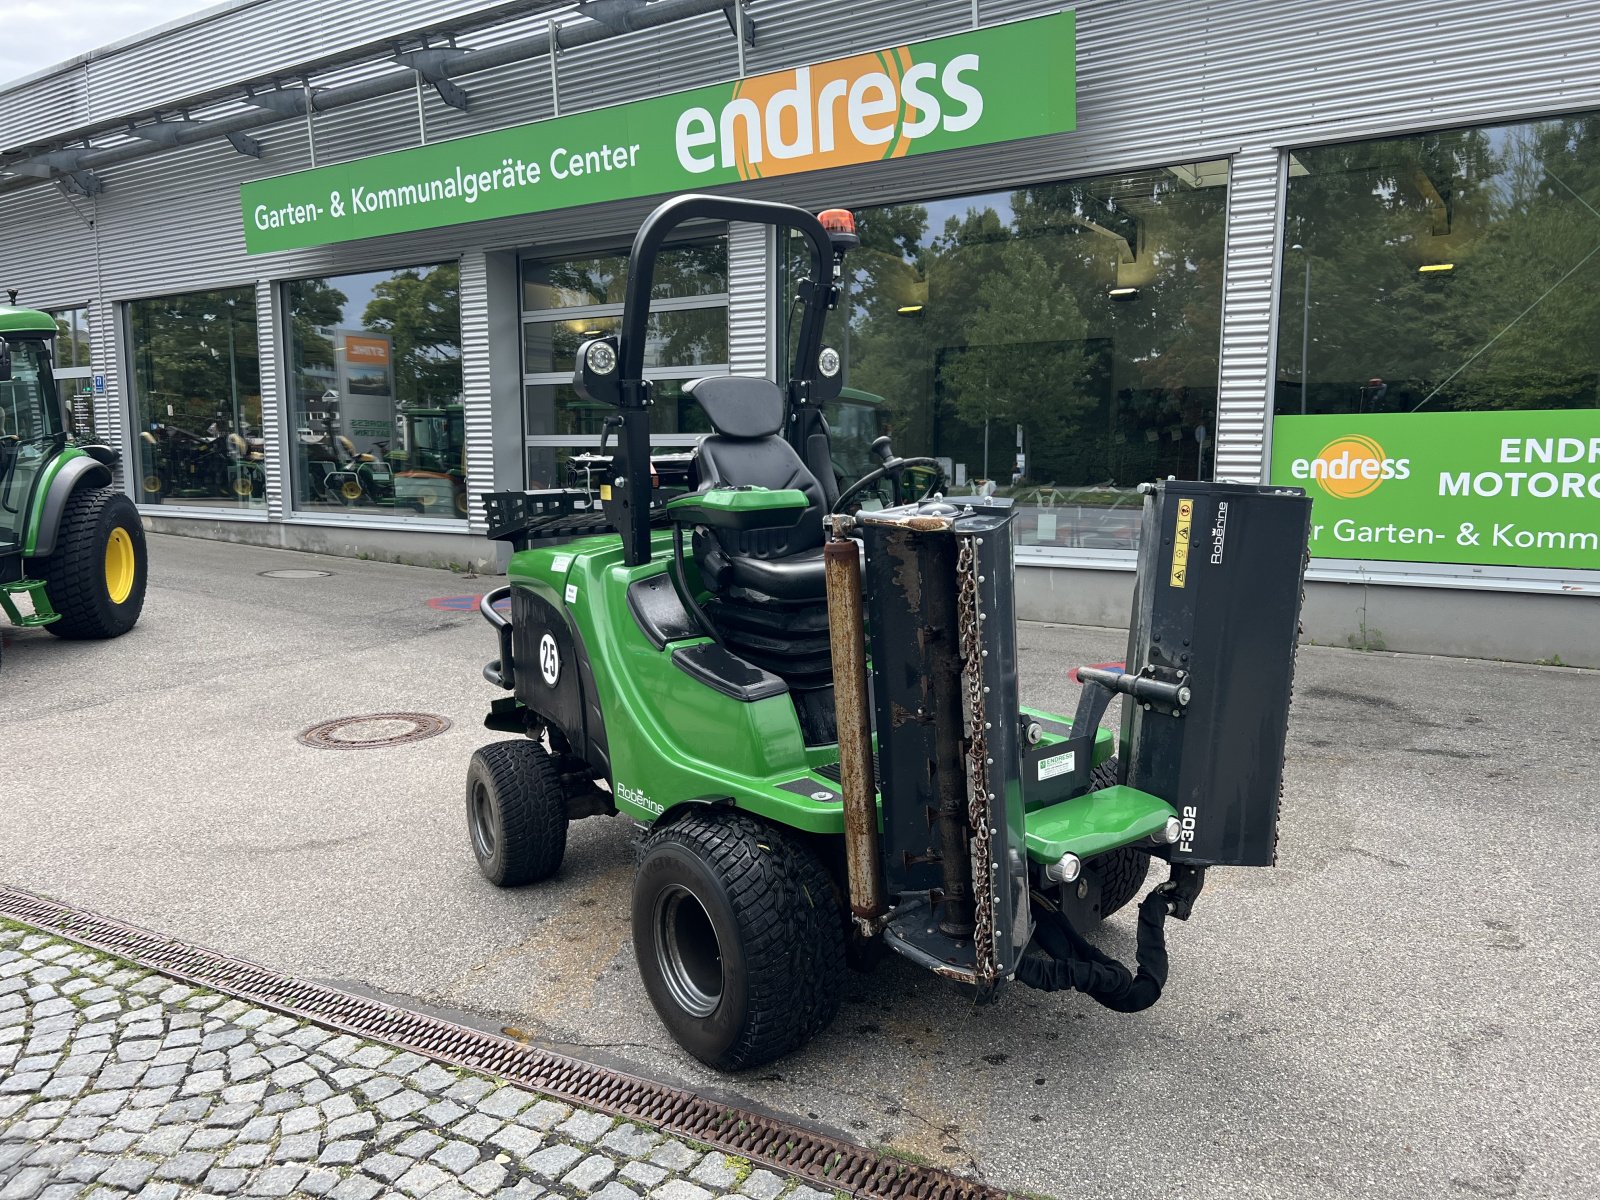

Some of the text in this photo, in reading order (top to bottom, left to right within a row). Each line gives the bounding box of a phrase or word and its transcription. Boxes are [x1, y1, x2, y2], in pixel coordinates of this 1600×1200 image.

[675, 54, 984, 174] endress
[254, 143, 640, 231] Garten- & Kommunalgeräte Center
[1291, 451, 1410, 480] endress
[1211, 501, 1228, 565] Roberine
[1333, 519, 1445, 544] Garten-
[1456, 522, 1480, 546] &
[1493, 523, 1598, 550] Komm
[543, 641, 556, 677] 25
[1046, 753, 1073, 765] ENDRESS
[617, 782, 665, 815] Roberine
[1180, 806, 1197, 853] F302
